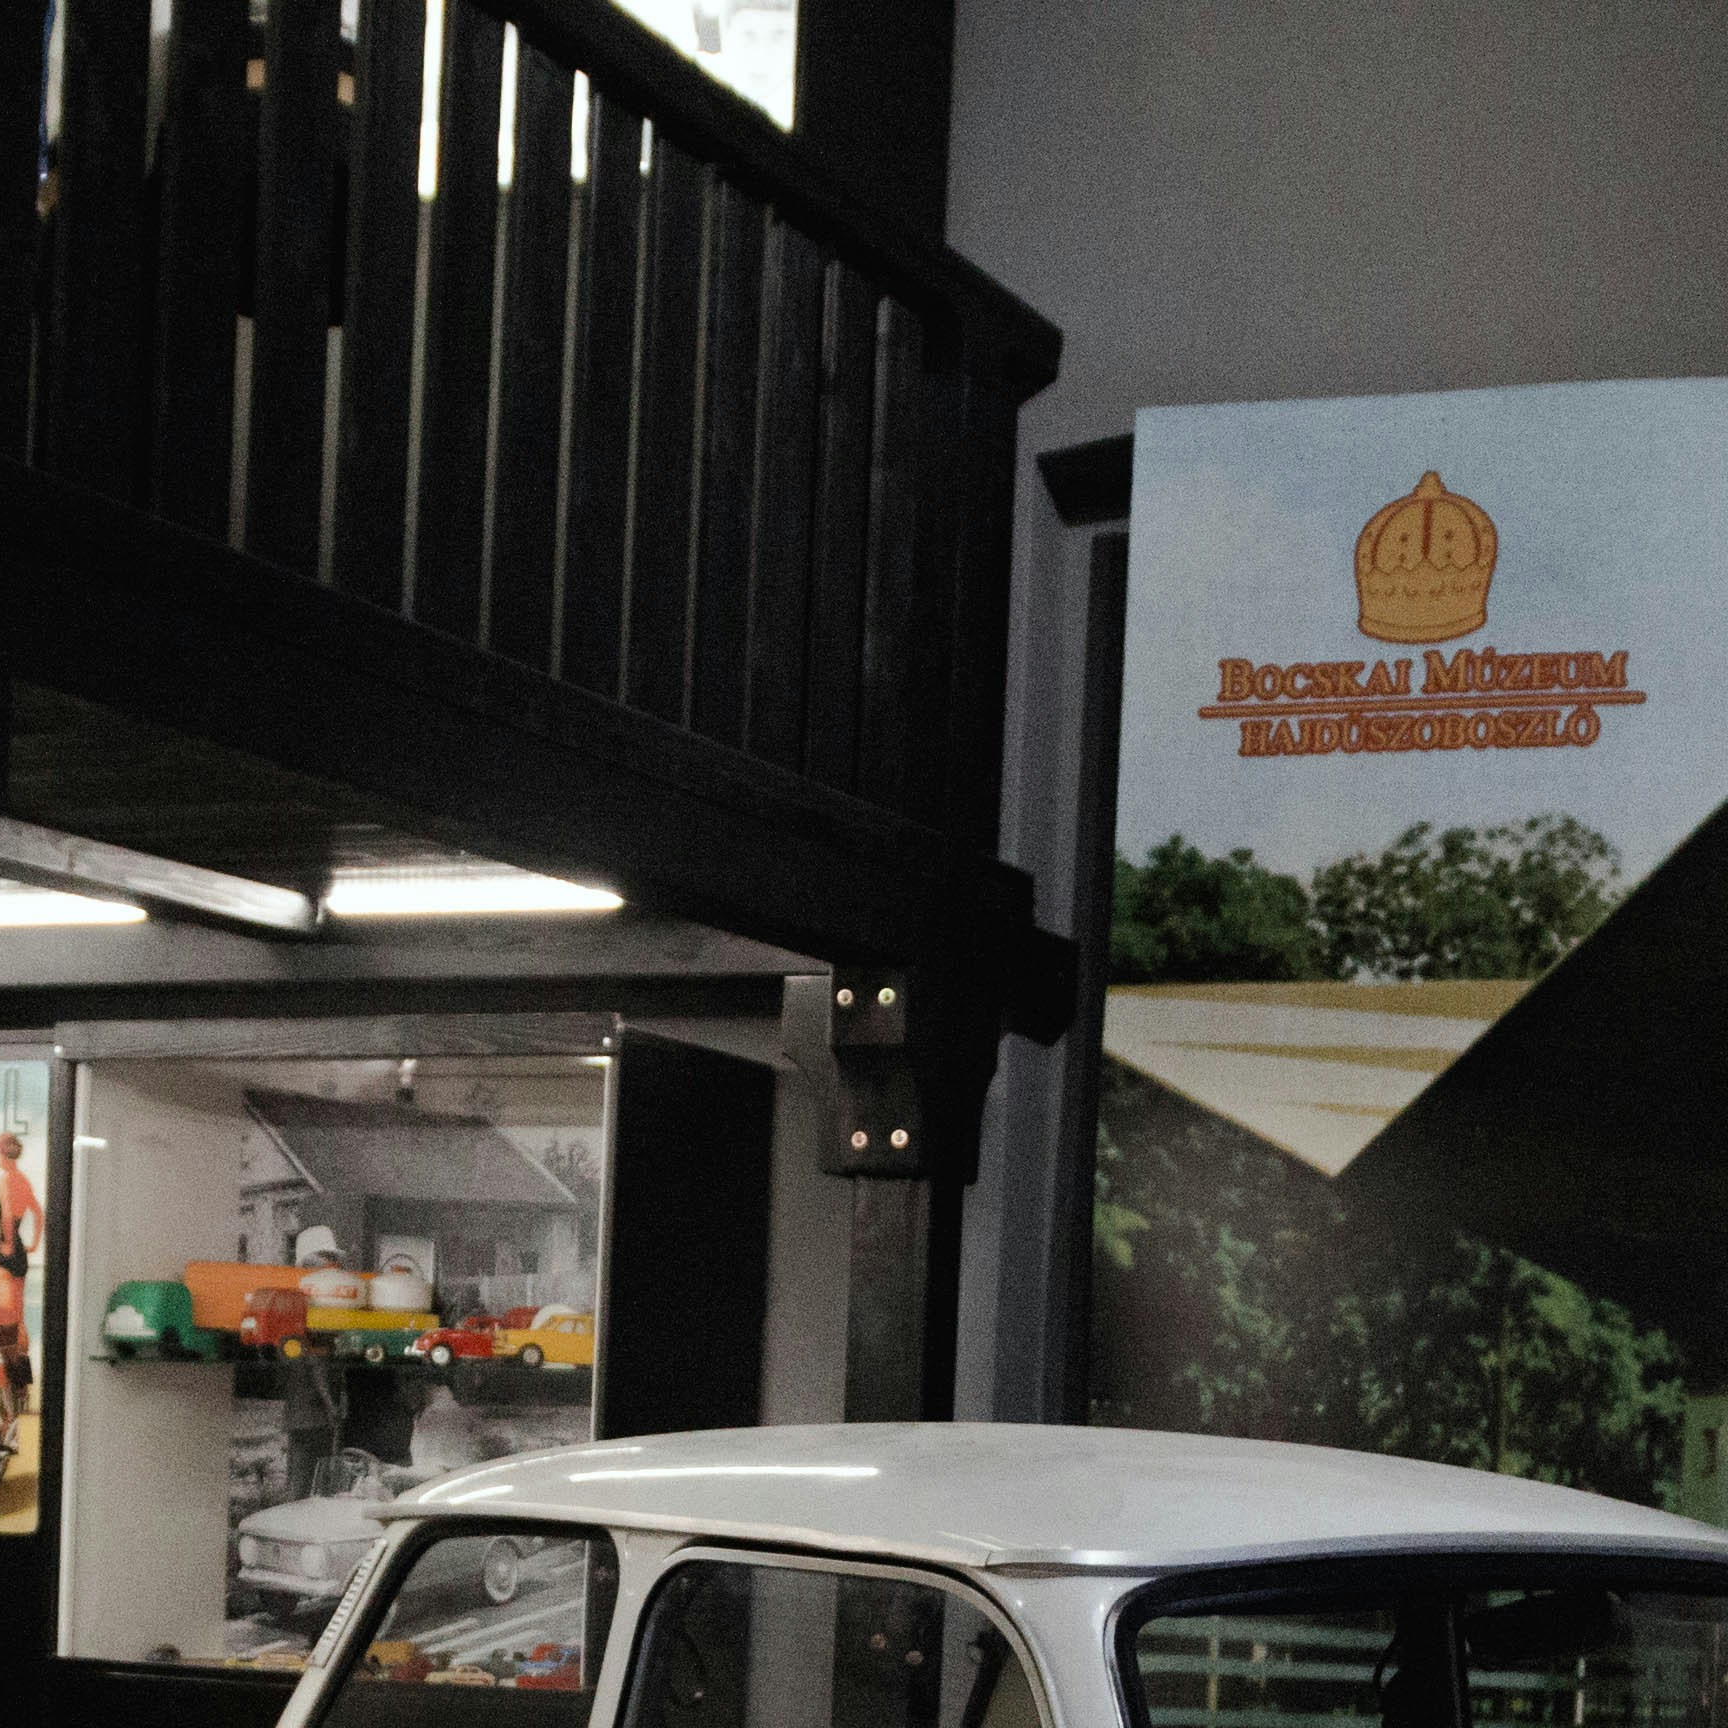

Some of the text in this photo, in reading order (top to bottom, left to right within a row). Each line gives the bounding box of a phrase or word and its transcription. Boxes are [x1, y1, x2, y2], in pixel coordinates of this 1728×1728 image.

[1217, 647, 1629, 702] BOCSKAI MÚZEUM
[1238, 704, 1601, 758] HAJDÚSZOBOSZLÓ
